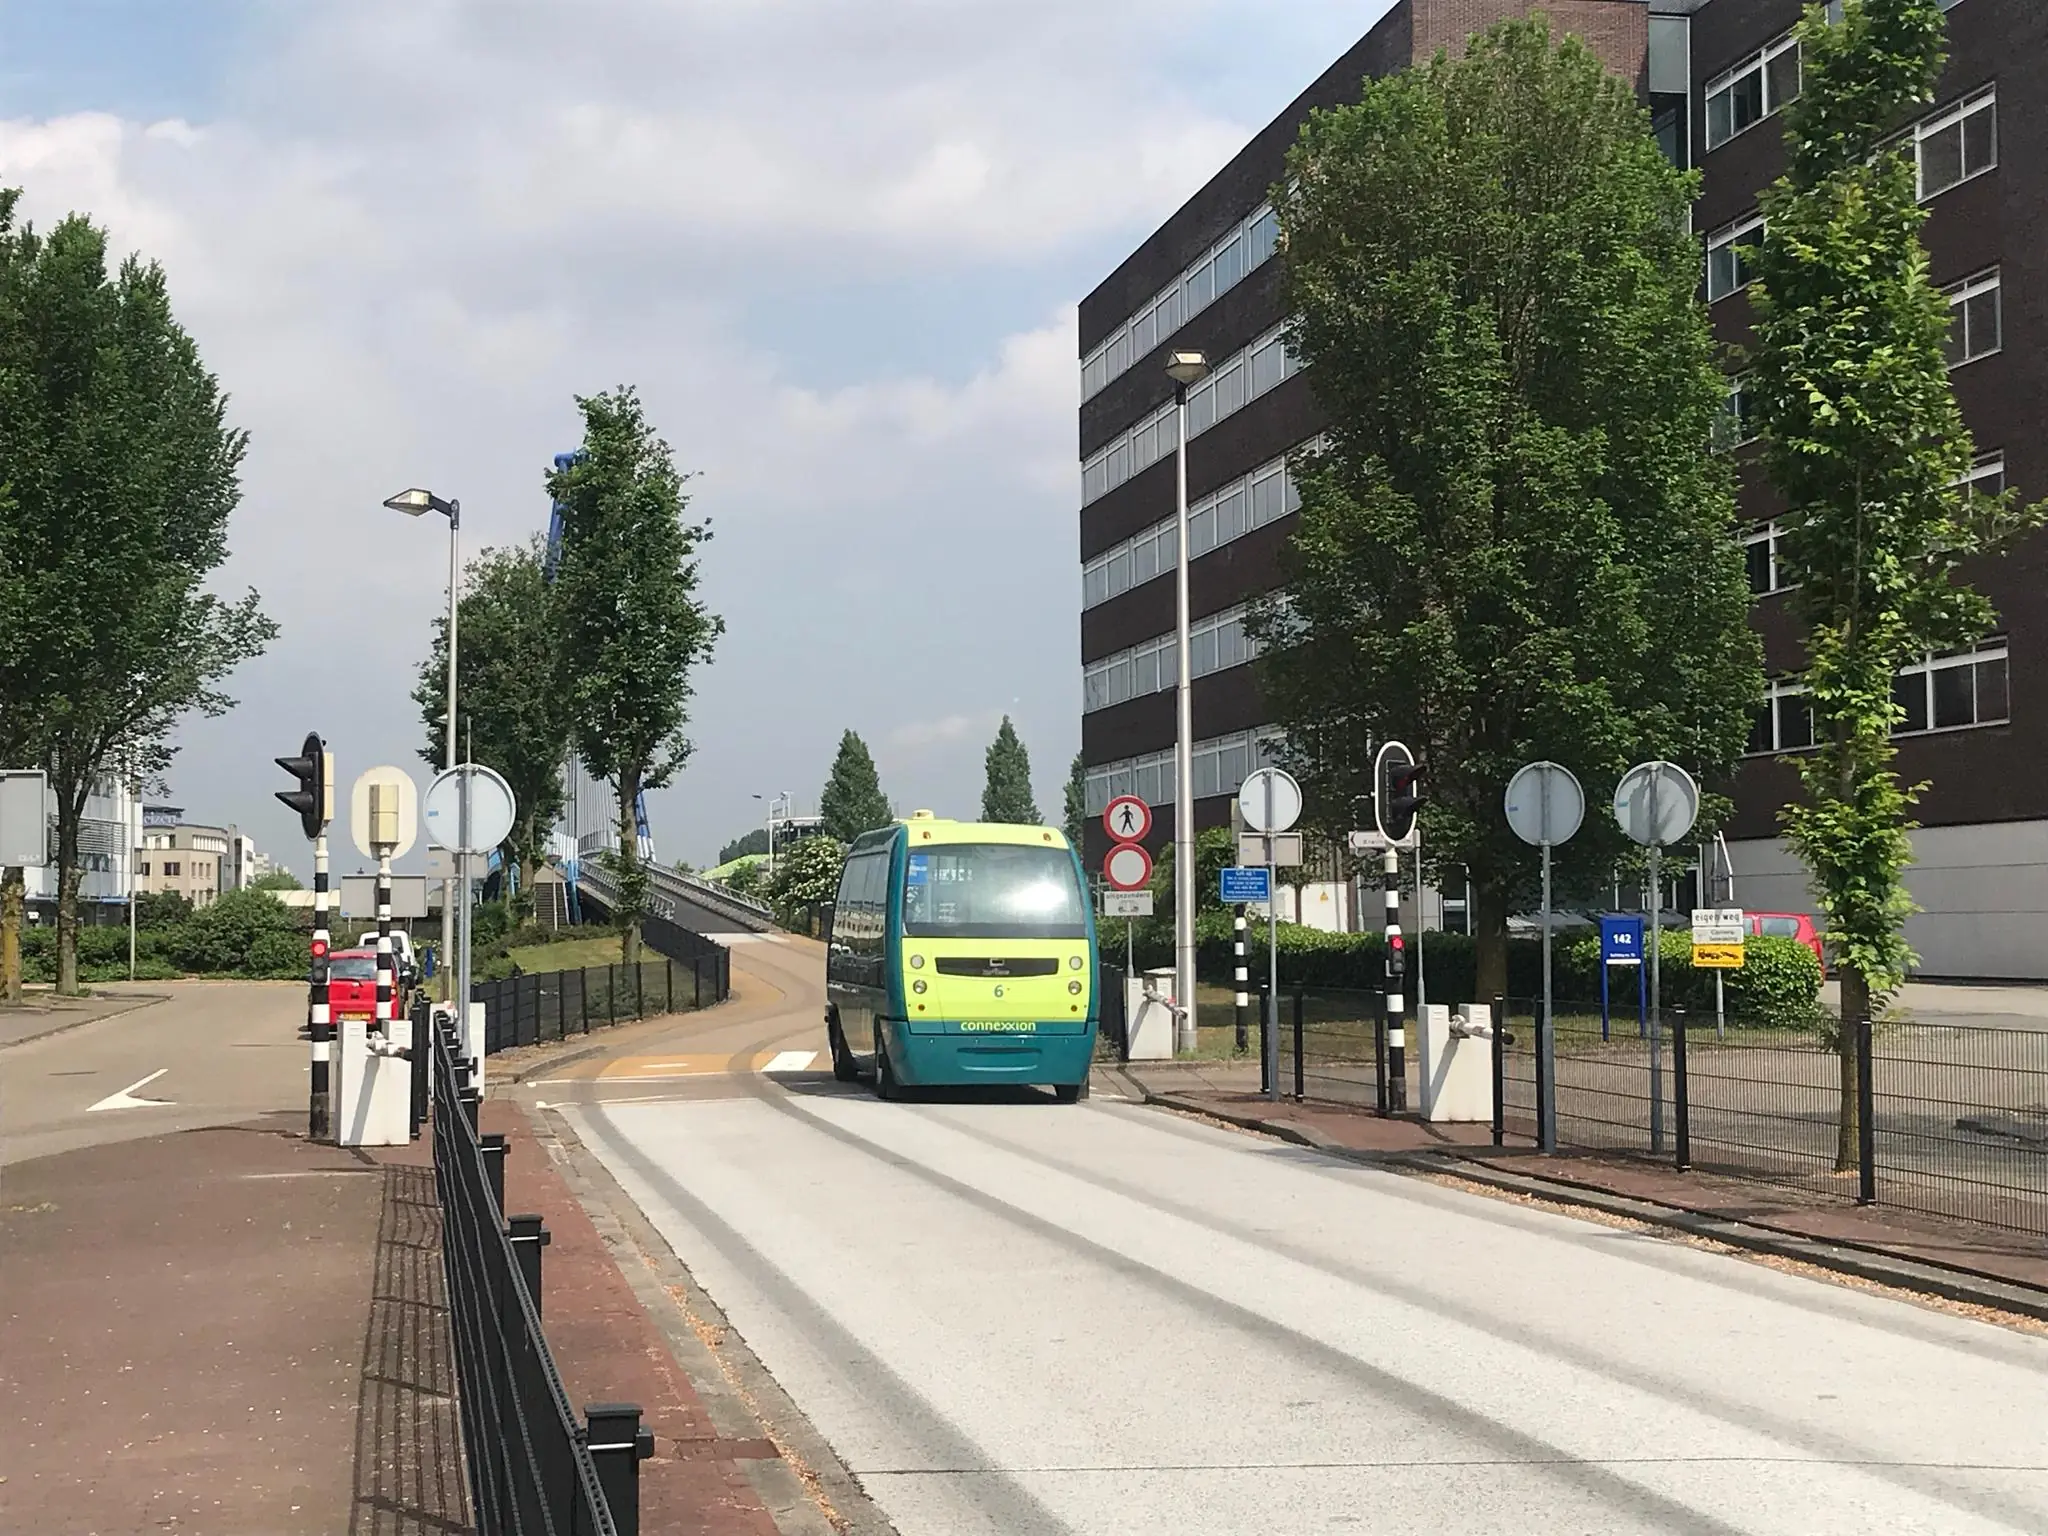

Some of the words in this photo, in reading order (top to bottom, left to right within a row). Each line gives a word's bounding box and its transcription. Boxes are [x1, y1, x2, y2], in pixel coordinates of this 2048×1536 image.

[1695, 914, 1720, 923] eigen
[1723, 914, 1740, 923] weg
[1613, 933, 1632, 944] 142
[994, 984, 1004, 998] 6
[960, 1021, 1037, 1032] connexxion
